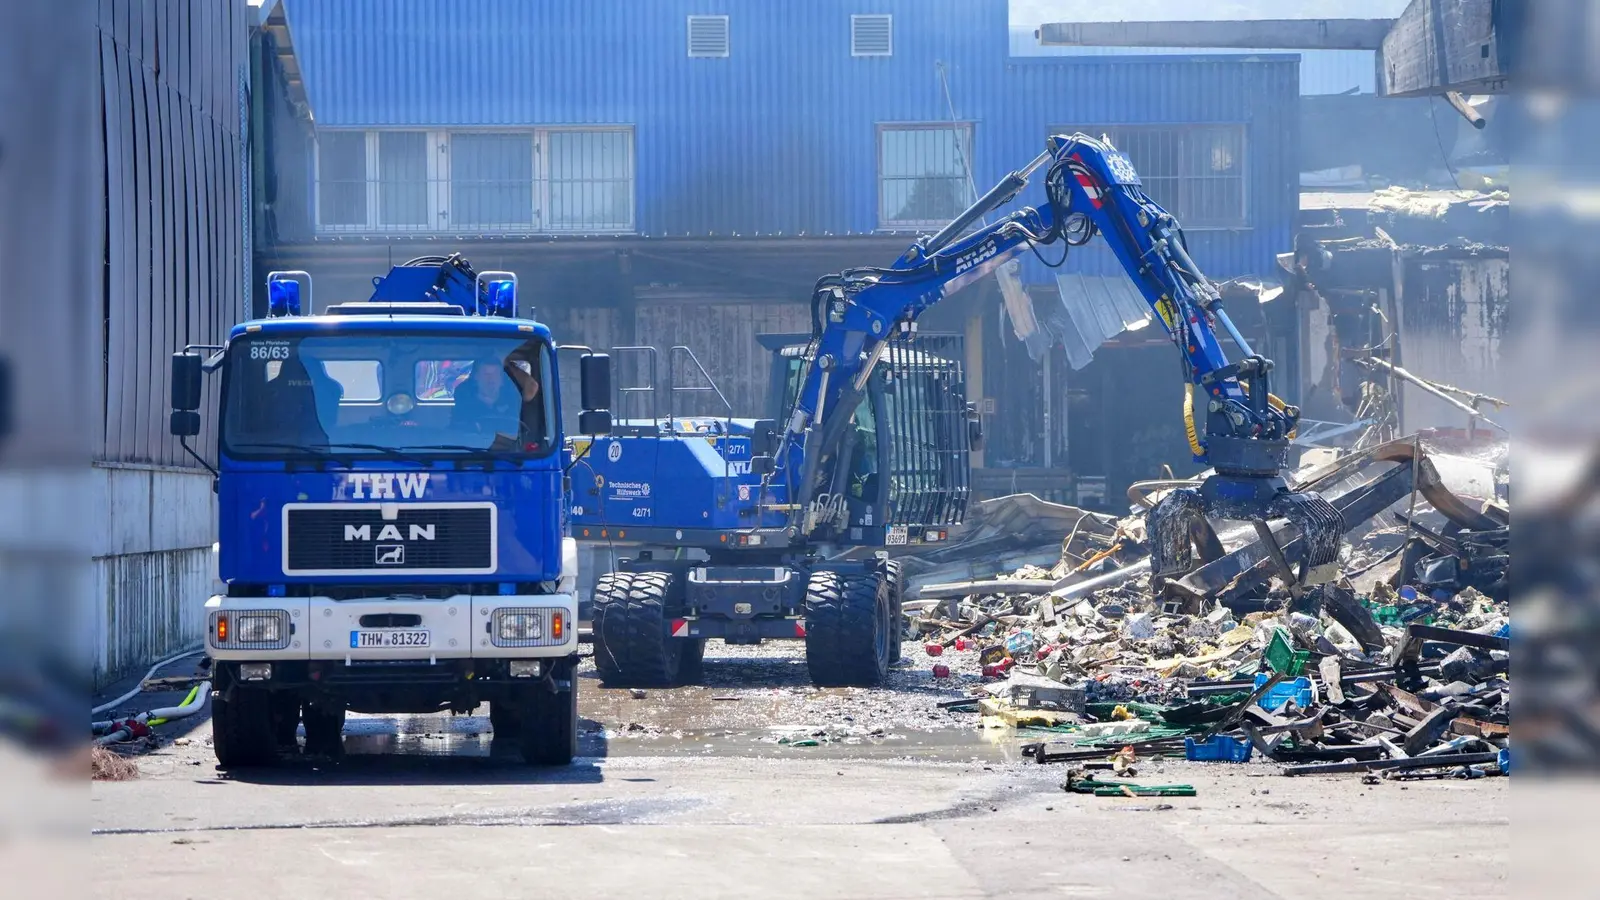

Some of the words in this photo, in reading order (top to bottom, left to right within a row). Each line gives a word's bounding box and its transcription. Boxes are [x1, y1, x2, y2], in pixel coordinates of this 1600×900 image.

[956, 239, 997, 274] ATLAS
[250, 346, 289, 359] 86/63
[610, 445, 620, 458] 20
[725, 444, 745, 454] 2/71
[347, 473, 430, 499] THW
[608, 481, 642, 489] Technisches
[616, 488, 642, 496] Hilfswerk
[632, 507, 651, 517] 42/71
[344, 524, 436, 541] MAN
[887, 534, 906, 544] 93691
[360, 632, 383, 646] THW
[391, 632, 428, 645] 81322
